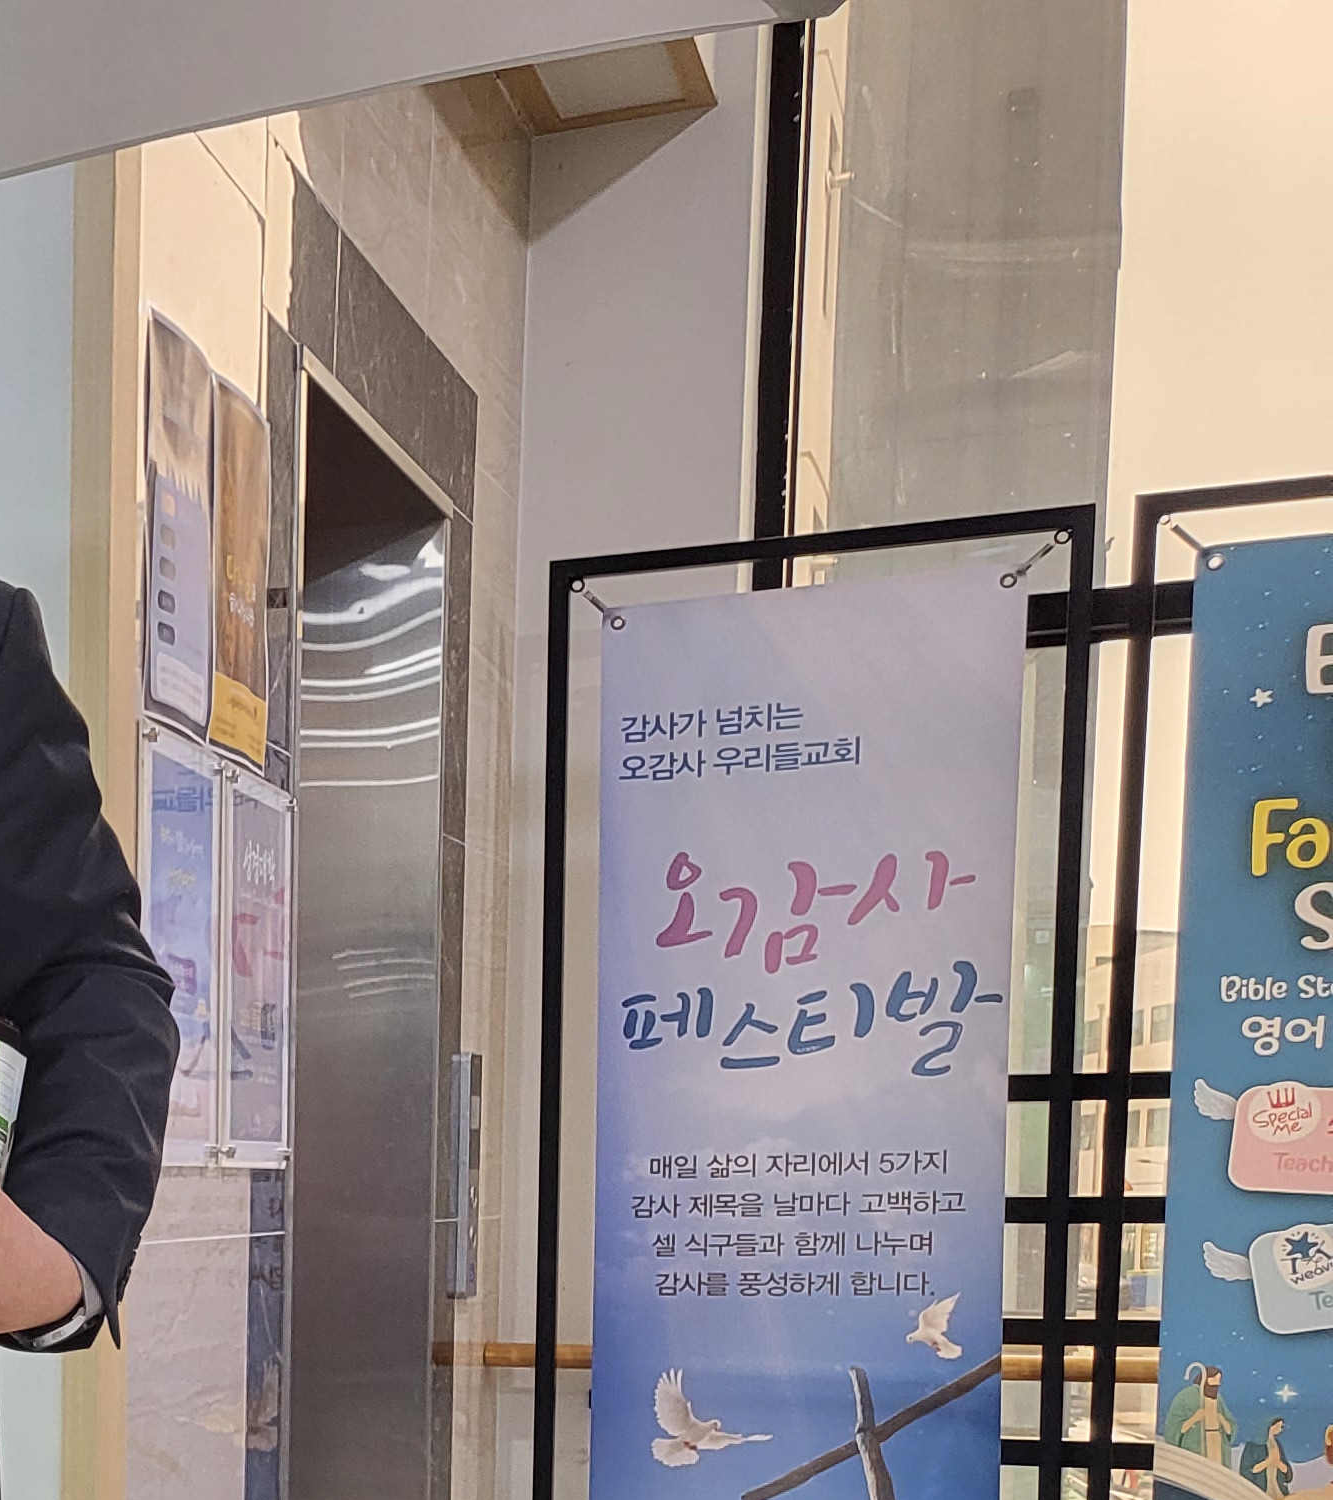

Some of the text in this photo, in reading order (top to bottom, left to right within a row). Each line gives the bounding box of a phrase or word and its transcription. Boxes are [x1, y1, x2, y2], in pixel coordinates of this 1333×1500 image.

[620, 702, 804, 744] 감사가 넘치는
[618, 736, 861, 781] 오감사 우리들교회
[656, 850, 977, 975] 오감사
[1219, 974, 1289, 1003] Bible
[621, 960, 1004, 1077] 페스티발
[1241, 1014, 1327, 1056] 영어
[1252, 1101, 1313, 1128] Special
[648, 1149, 949, 1179] 매일 삶의 자리에서 5가지
[631, 1190, 967, 1219] 감사 제목을 날마다 고백하고
[651, 1230, 934, 1258] 셀 식구들과 함께 나누며
[654, 1271, 935, 1297] 감사를 풍성하게 합니다.
